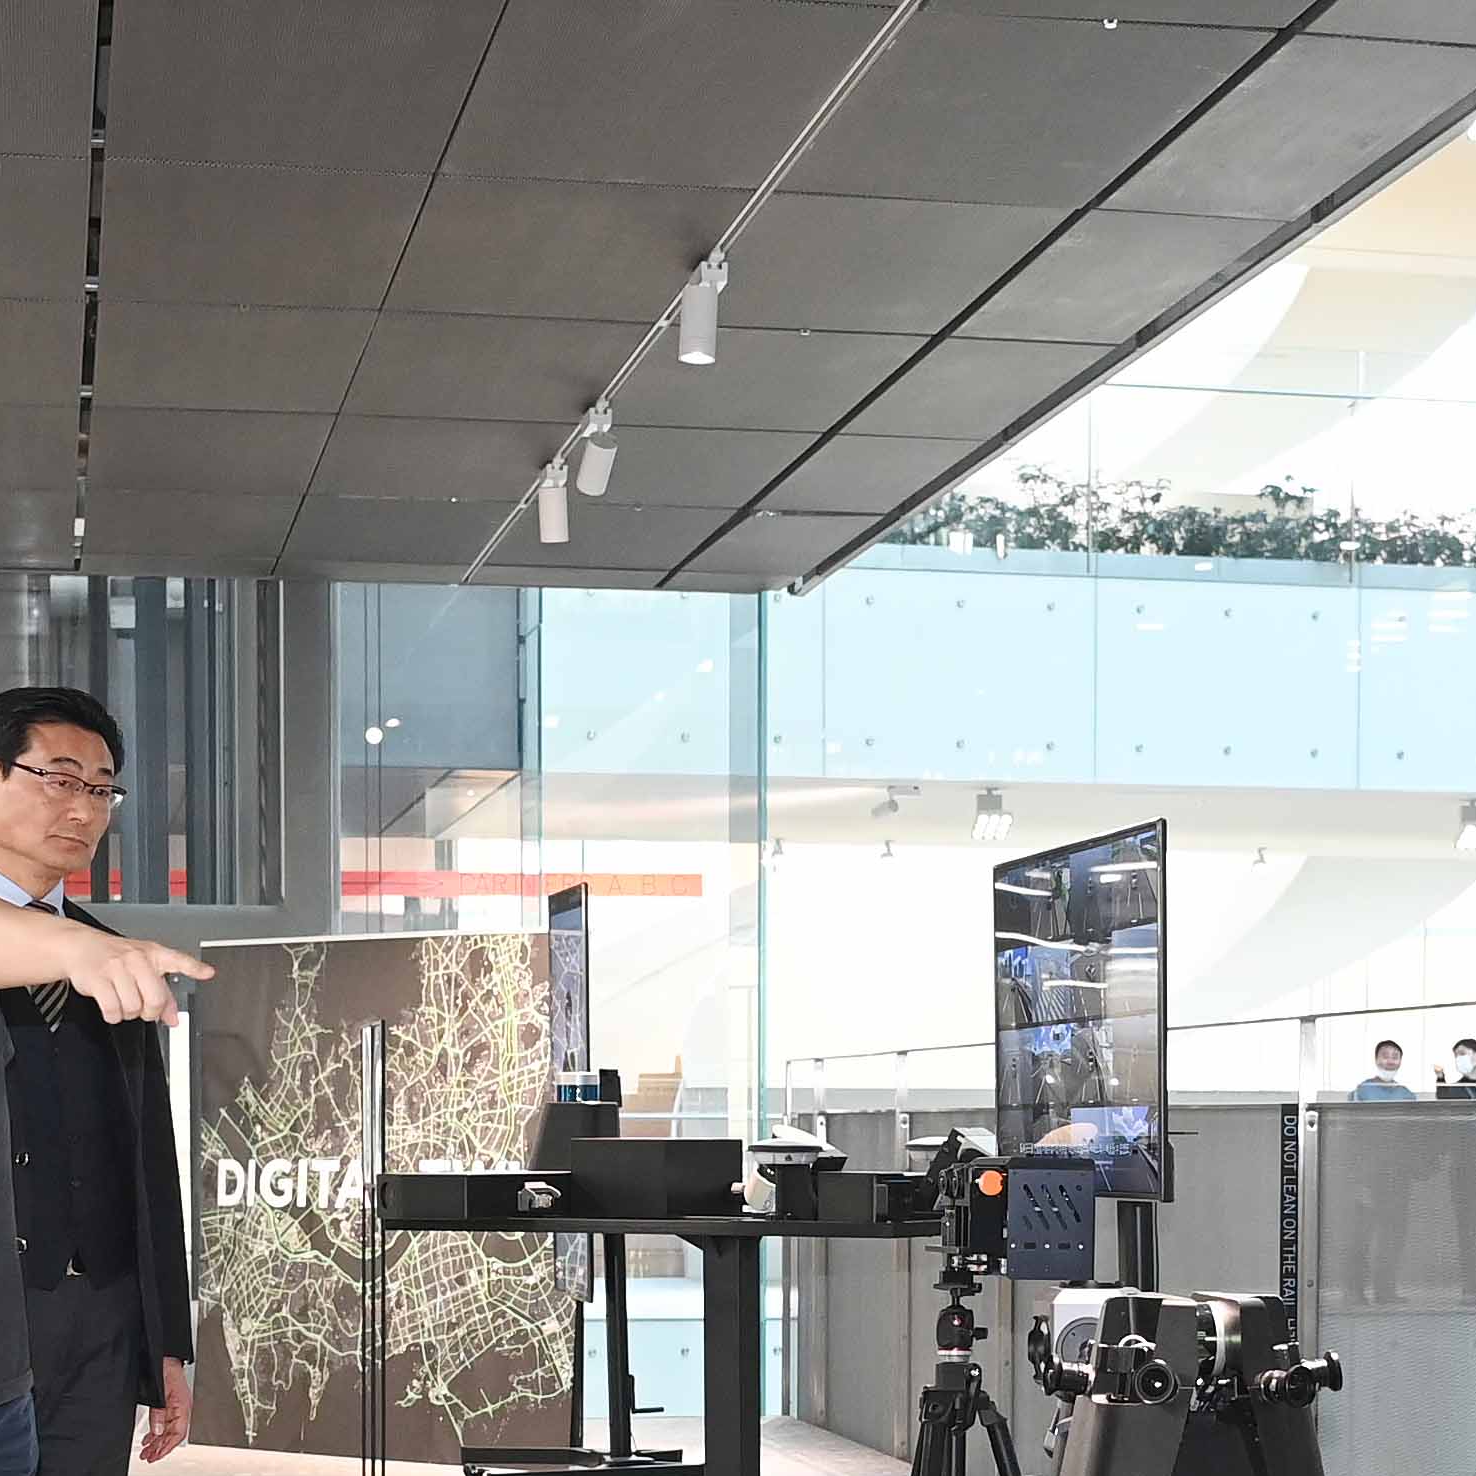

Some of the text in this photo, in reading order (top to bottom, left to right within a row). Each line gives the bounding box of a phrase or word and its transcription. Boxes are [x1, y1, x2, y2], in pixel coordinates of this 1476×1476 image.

[1284, 1115, 1297, 1137] DO
[1284, 1140, 1297, 1171] NOT
[217, 1157, 377, 1209] DIGITA
[1283, 1175, 1297, 1214] LEAN
[1283, 1218, 1296, 1240] ON
[1283, 1243, 1296, 1274] THE
